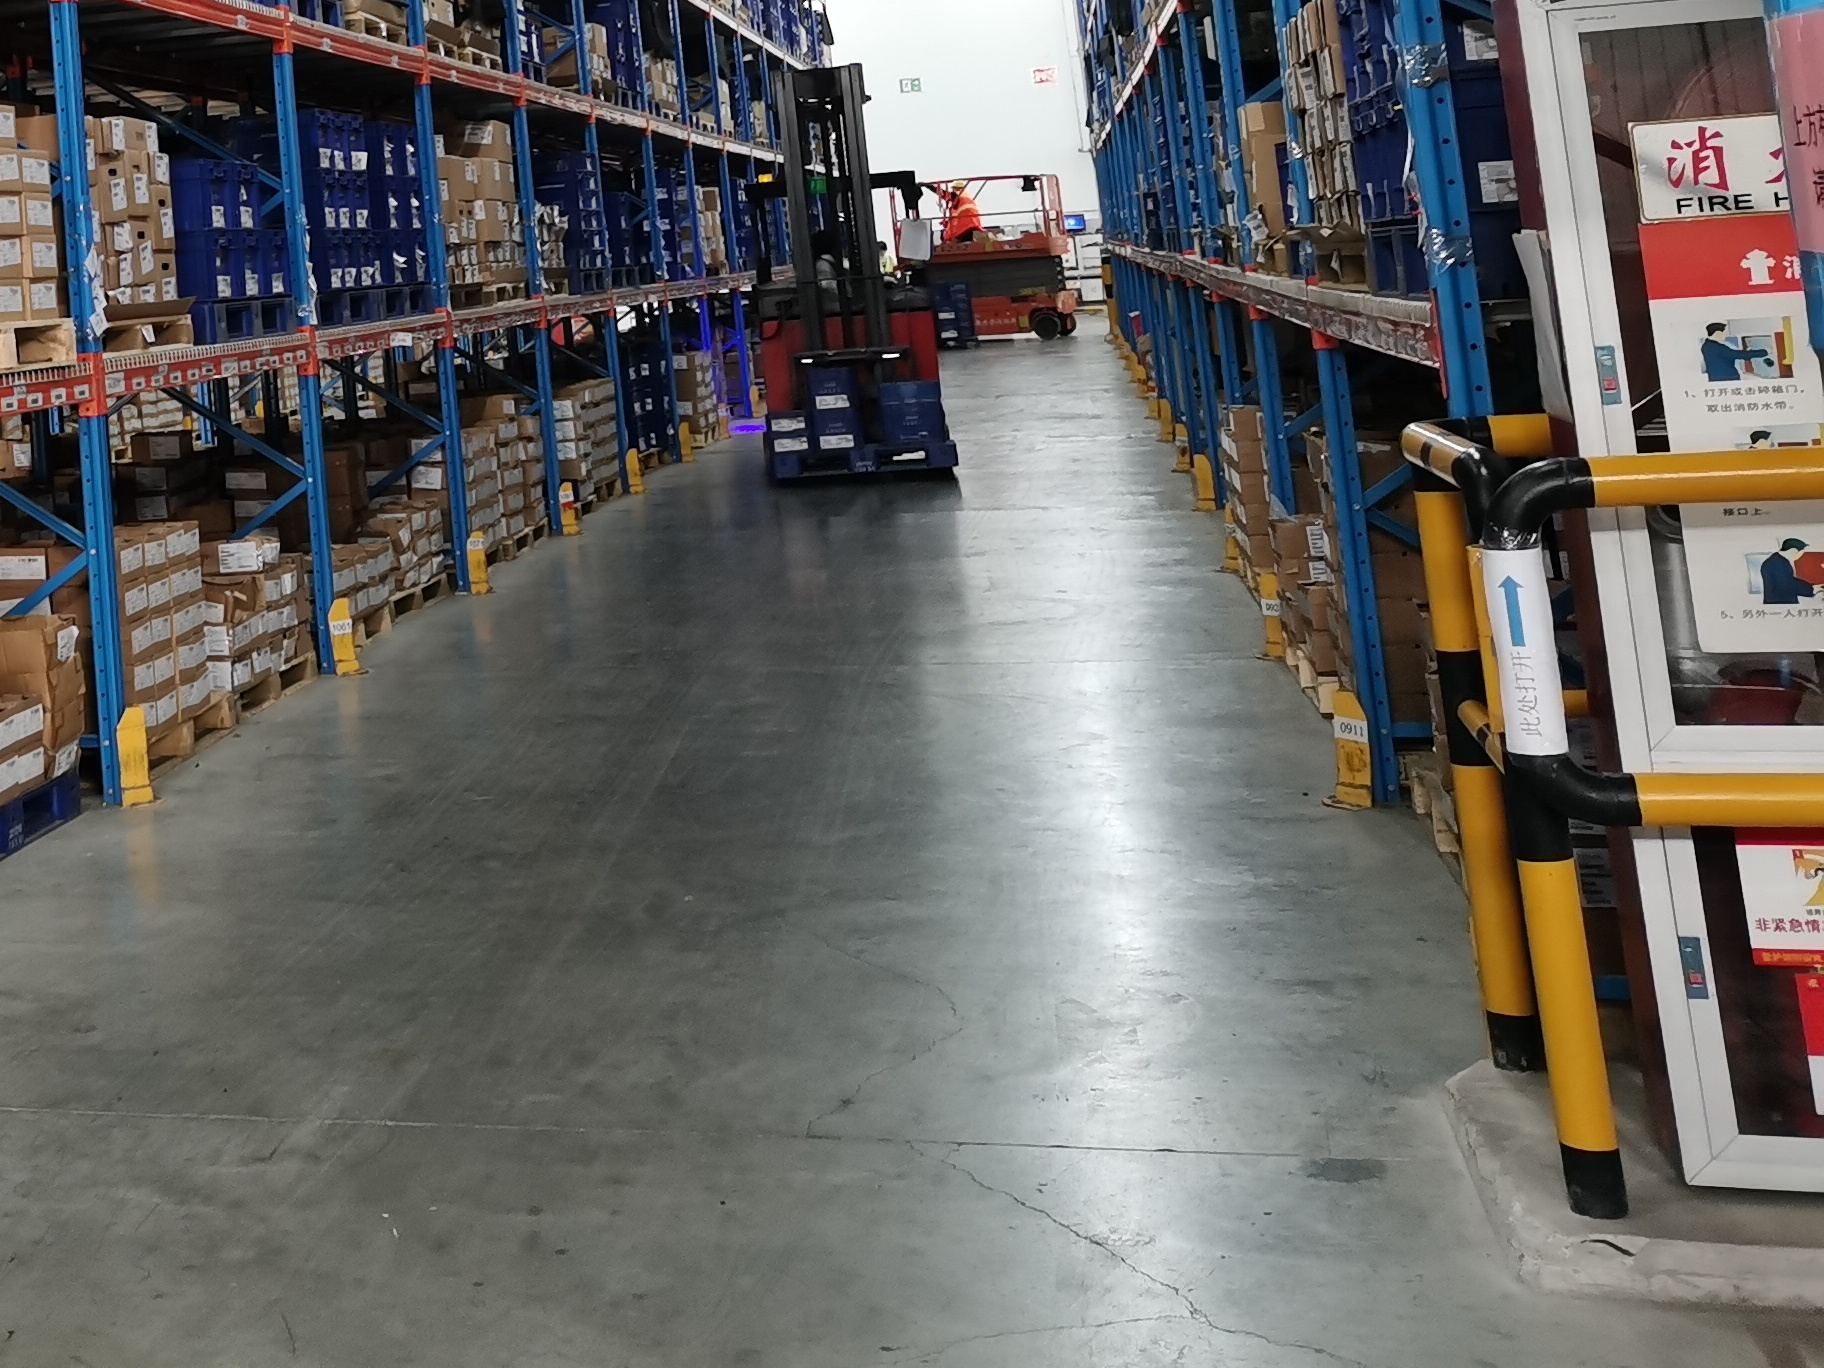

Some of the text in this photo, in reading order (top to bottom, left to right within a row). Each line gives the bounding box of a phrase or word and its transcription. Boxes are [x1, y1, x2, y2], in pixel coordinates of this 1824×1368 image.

[1676, 193, 1755, 215] FIRE
[1510, 650, 1543, 738] 此处打开
[1754, 917, 1824, 933] 非紧急情
